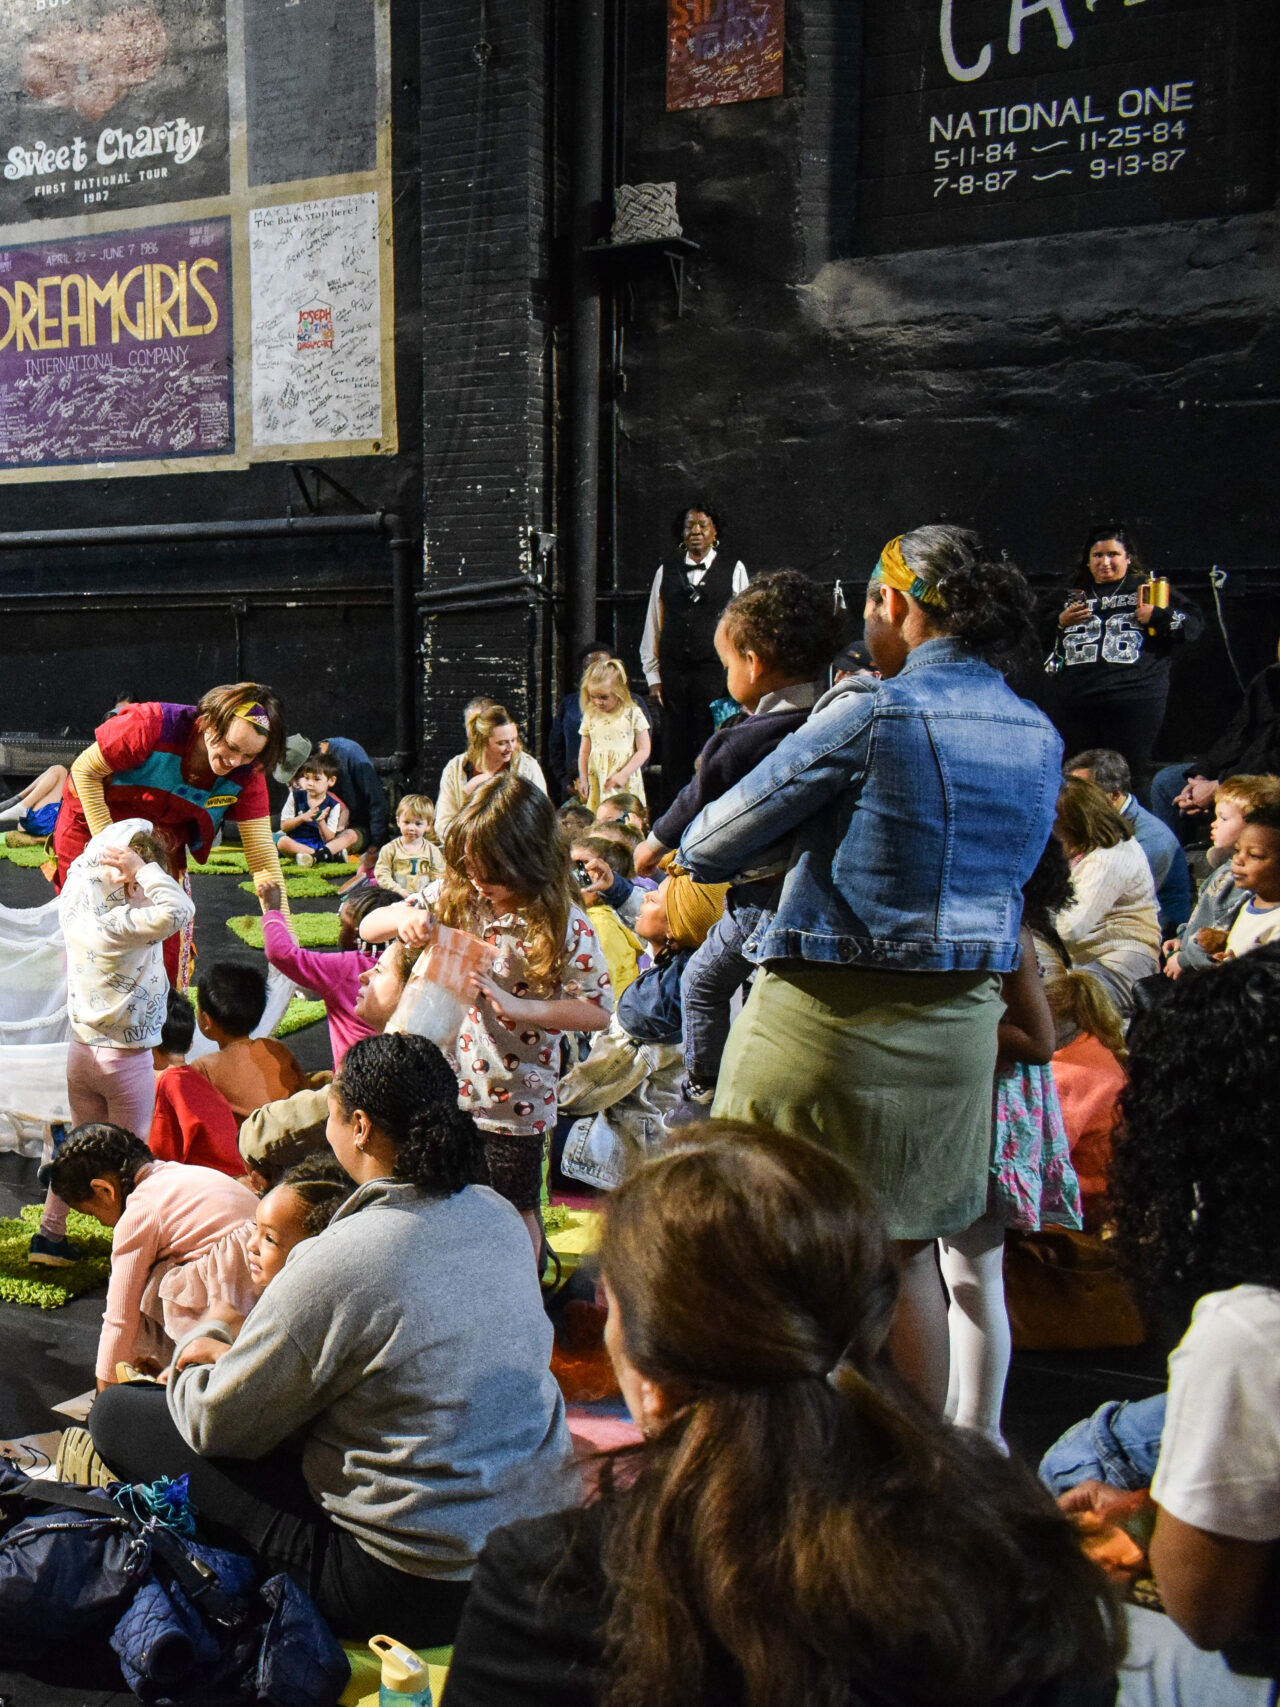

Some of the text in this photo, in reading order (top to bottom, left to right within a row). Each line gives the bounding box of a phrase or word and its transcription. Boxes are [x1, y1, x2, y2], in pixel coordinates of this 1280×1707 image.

[940, 0, 1147, 81] CA
[929, 81, 1194, 142] NATIONAL ONE
[4, 117, 205, 180] Sweet Charity
[934, 141, 1017, 170] 5-11-84
[1080, 120, 1185, 151] 11-25-84
[34, 167, 168, 197] FIRST NATIONAL TOUR
[933, 170, 1017, 197] 7-8-87
[1090, 149, 1186, 179] 9-13-87
[83, 190, 110, 204] 1987
[255, 219, 274, 229] The
[46, 253, 70, 267] APRIL
[75, 252, 87, 263] 22
[100, 245, 124, 260] JUNE
[128, 244, 135, 255] 7
[298, 307, 332, 325] JOSEPH
[25, 345, 190, 376] INTERNATIONAL COMPANY
[1101, 592, 1138, 610] MES
[1063, 612, 1144, 666] 26
